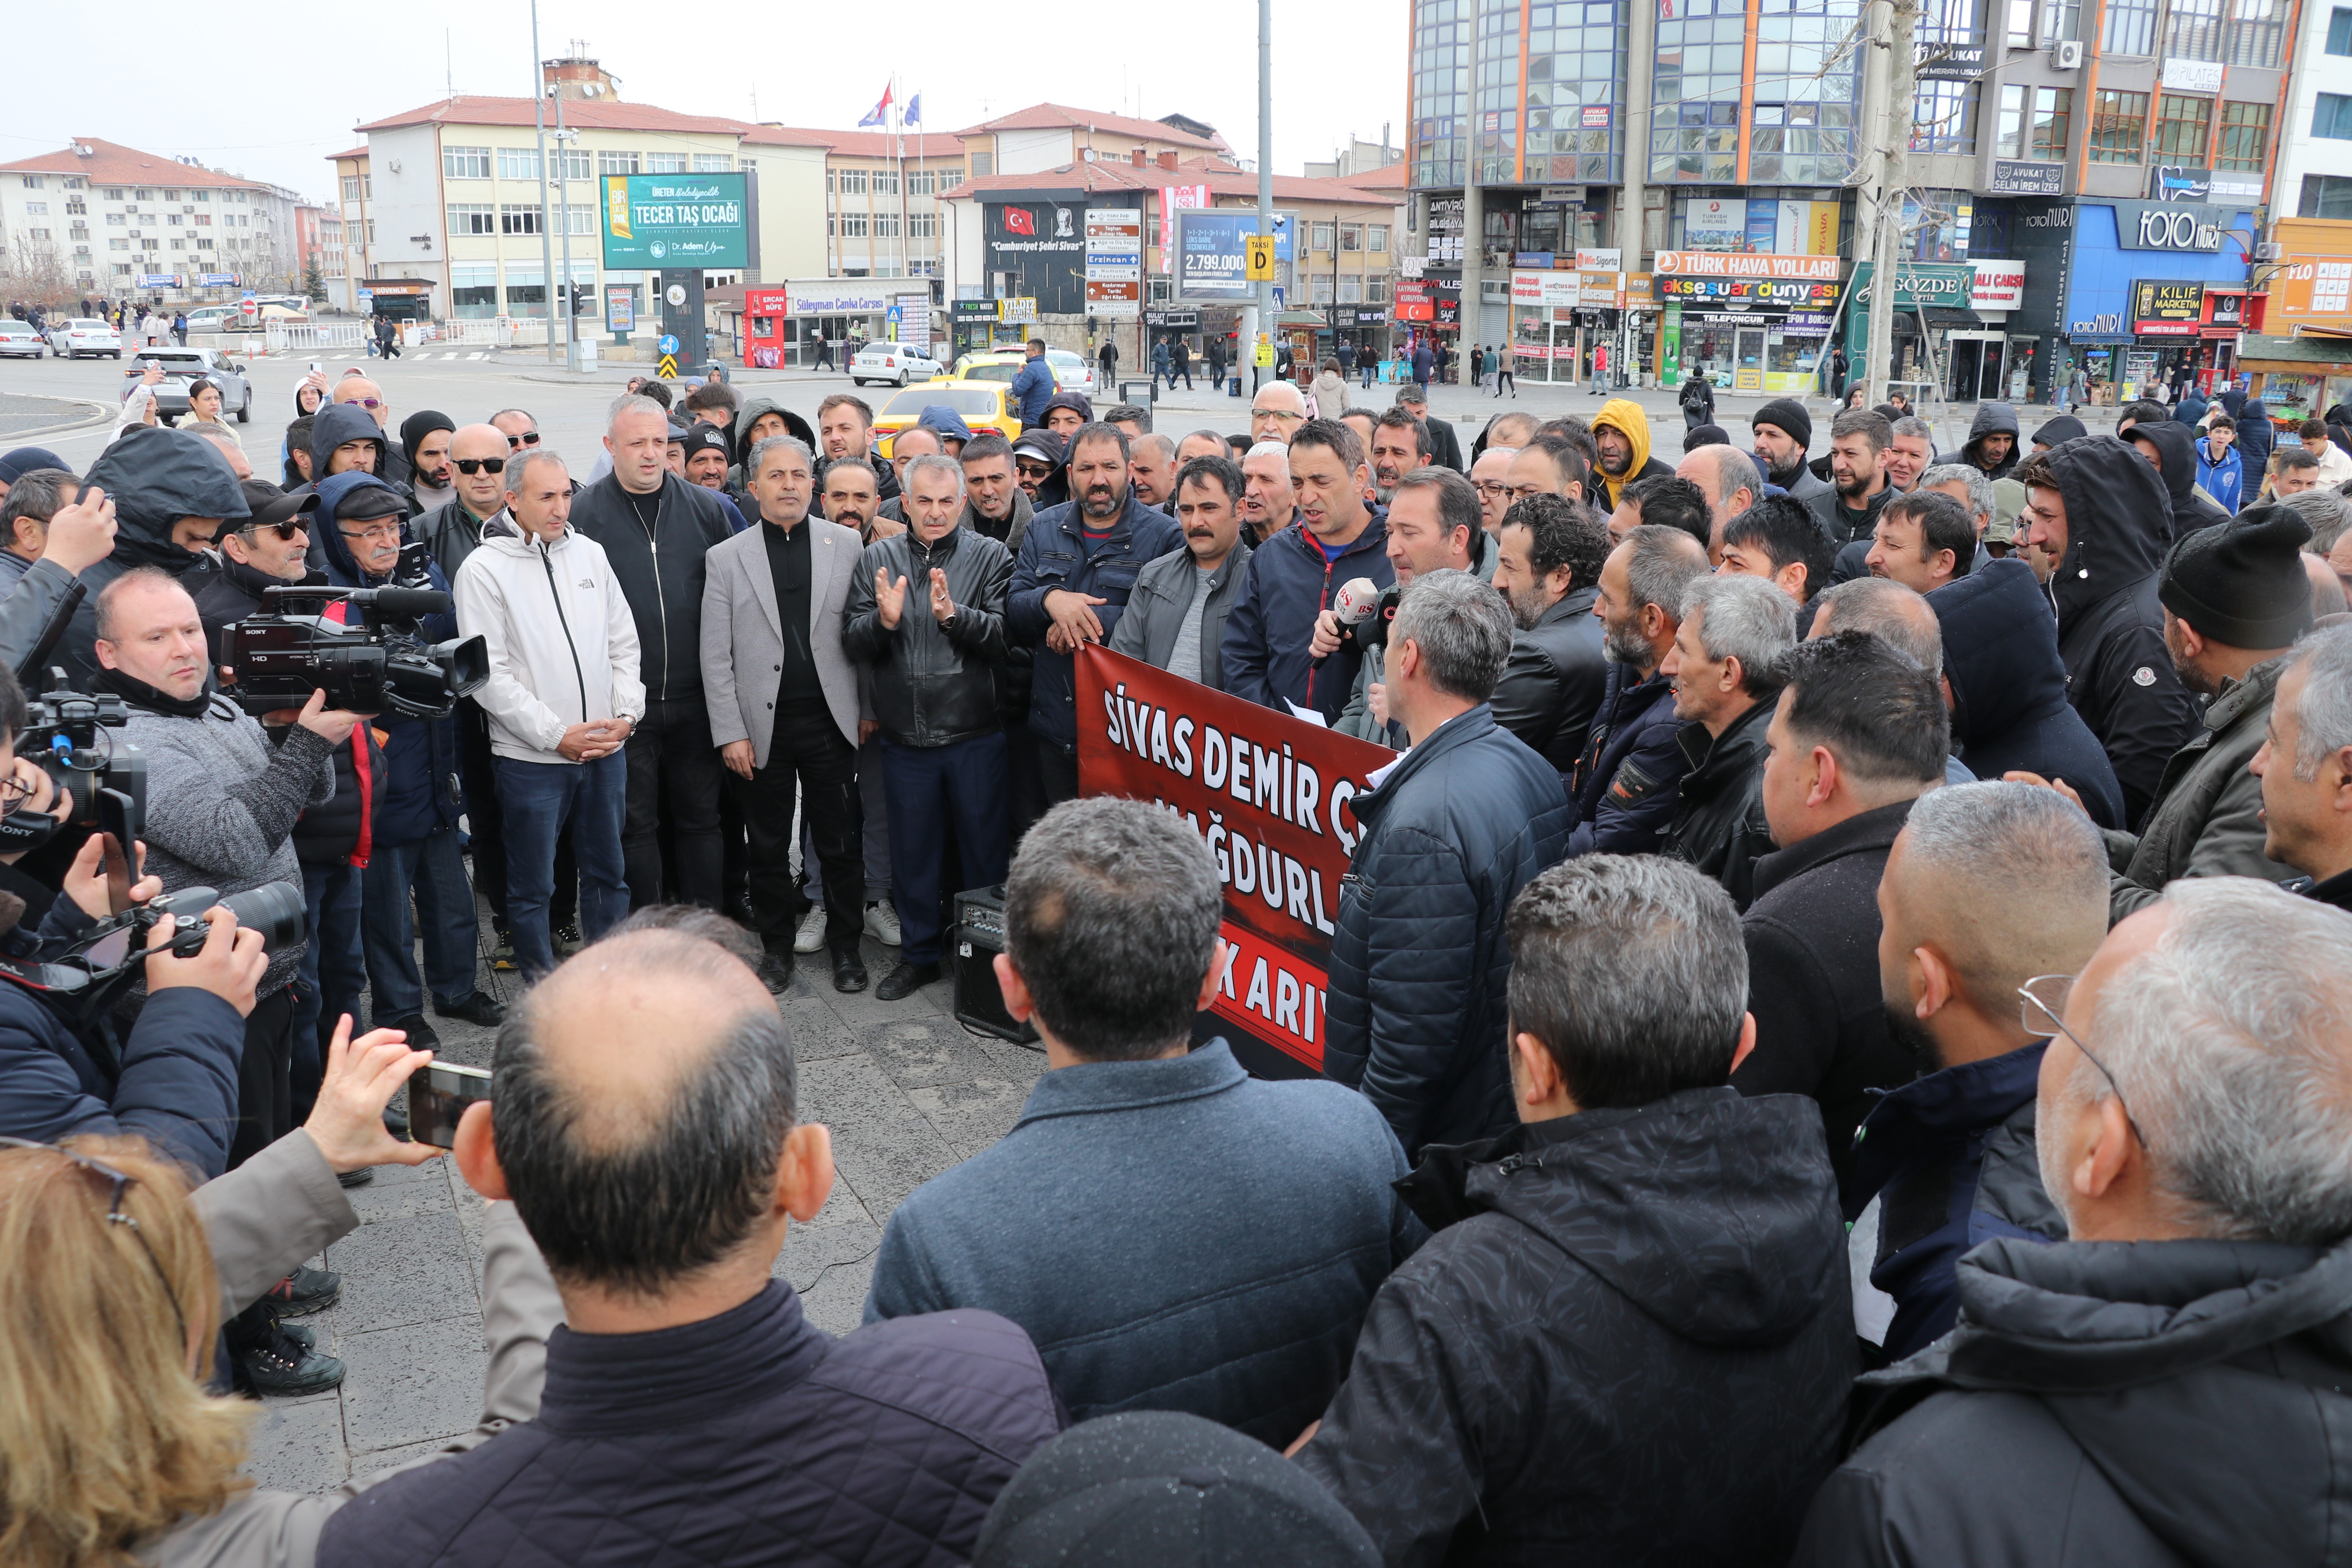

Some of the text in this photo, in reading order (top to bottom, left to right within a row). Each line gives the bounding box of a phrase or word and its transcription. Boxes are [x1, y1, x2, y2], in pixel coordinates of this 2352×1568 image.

[2180, 67, 2220, 83] PILATES
[2013, 169, 2044, 178] AVUKAT
[1994, 178, 2059, 192] SELİN İREM İZER
[2164, 177, 2192, 189] Titanium
[2190, 181, 2210, 190] Dental
[612, 188, 625, 204] BİR
[652, 186, 720, 200] ÜRETEN Belediyecilik
[1430, 199, 1465, 212] ANTİVİRÜ
[635, 201, 738, 226] TECER TAŞ OCAĞI
[1430, 217, 1465, 229] BİLGİSAYA
[1819, 213, 1829, 256] PEGASUS
[2138, 211, 2221, 249] FOTO NURİ
[672, 242, 681, 250] Dr.
[704, 241, 726, 254] Uzun
[1039, 241, 1058, 252] Şehri
[1186, 243, 1216, 251] SEÇENEKLERİ
[1186, 254, 1246, 270] 2.799.000
[1255, 252, 1266, 269] D
[1685, 254, 1836, 277] TÜRK HAVA YOLLARI
[2288, 264, 2313, 280] FLO
[1662, 279, 1752, 296] aksesuar
[1893, 275, 1957, 293] GÖZDE
[1994, 274, 2024, 289] ÇARŞI
[1397, 285, 1423, 294] KAYMAKÇI
[1512, 288, 1541, 298] Fotoğrafçılık
[1581, 286, 1616, 301] aksesuar
[1990, 292, 2015, 300] MERKEZİ
[2160, 287, 2197, 298] KILIF
[1911, 293, 1935, 301] OPTİK
[2154, 298, 2200, 309] MARKETİM
[797, 297, 883, 313] Süleyman Çanka Çarşısı
[1003, 299, 1035, 309] YILDIZ
[1440, 300, 1456, 308] SEMA
[1338, 309, 1356, 318] ÇELİKUS
[1373, 311, 1385, 320] OPTİK
[1703, 315, 1764, 323] TELEFONCUM
[2214, 312, 2241, 321] MEYDAN BÜFE
[1339, 587, 1352, 607] BS
[1357, 603, 1374, 614] BS
[395, 707, 419, 717] SONY
[1103, 682, 1195, 778] SİVAS
[1203, 724, 1323, 836] DEMİR
[1245, 956, 1327, 1044] ARI
